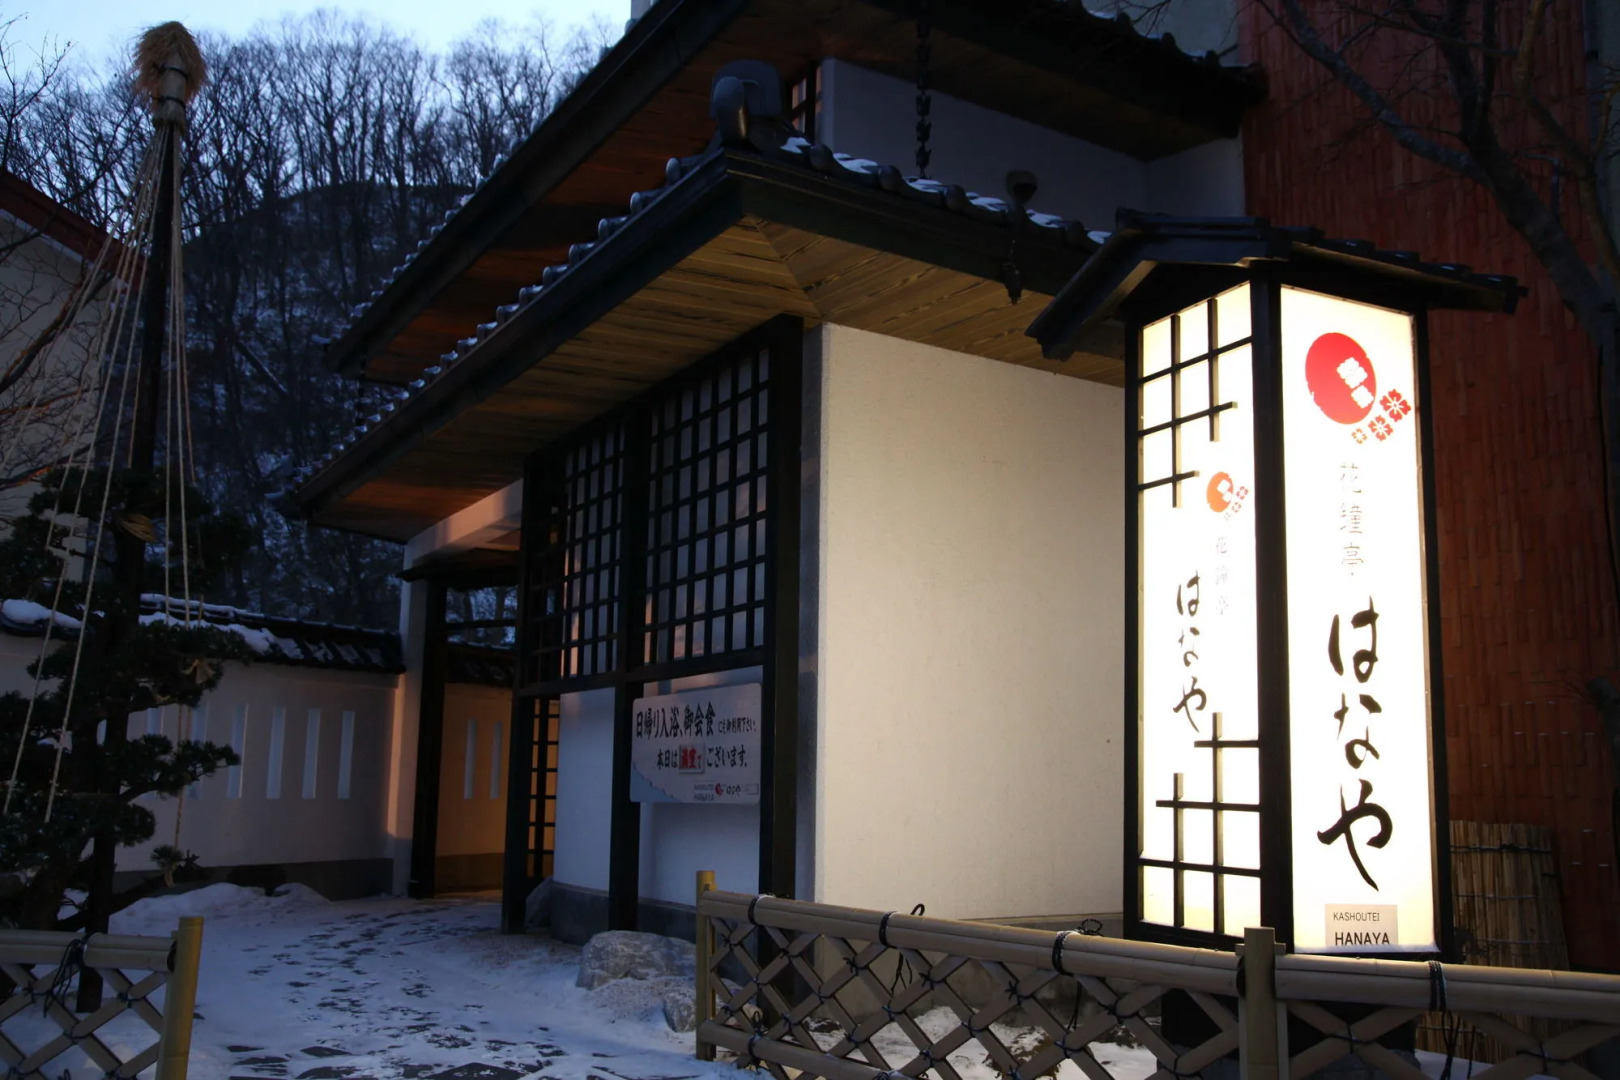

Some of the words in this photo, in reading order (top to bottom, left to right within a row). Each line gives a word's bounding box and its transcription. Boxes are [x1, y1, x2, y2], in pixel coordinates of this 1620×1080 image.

[1173, 570, 1208, 734] はなや
[1317, 595, 1393, 891] はなや
[1333, 912, 1380, 922] KASHOUTEI
[1334, 931, 1390, 946] HANAYA
